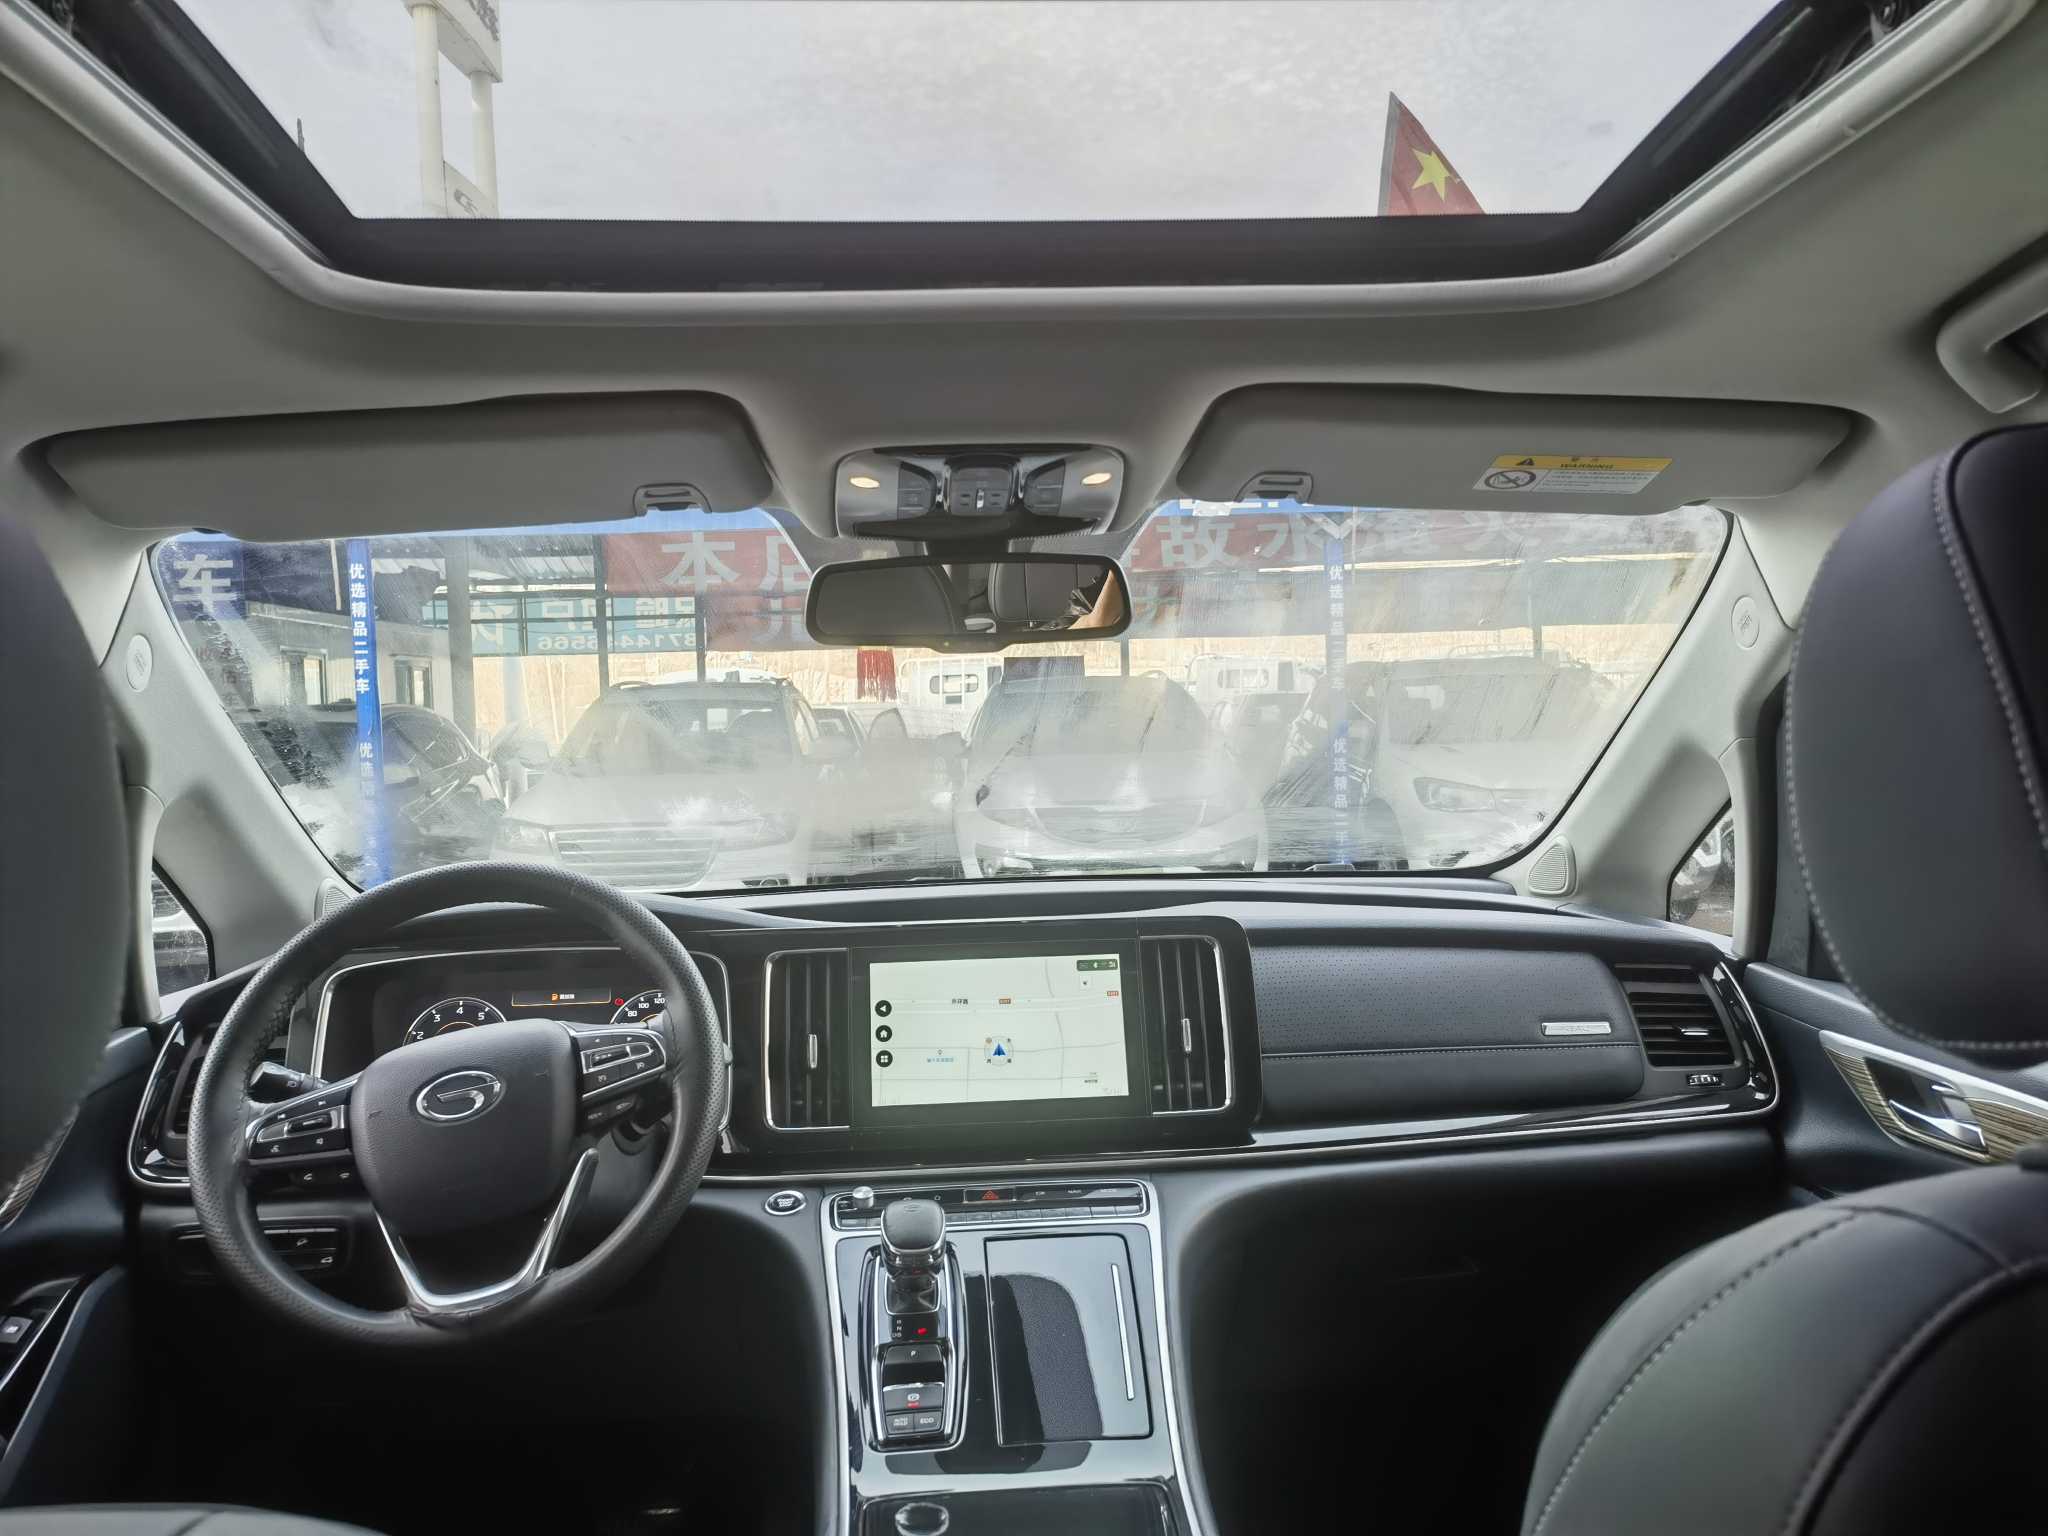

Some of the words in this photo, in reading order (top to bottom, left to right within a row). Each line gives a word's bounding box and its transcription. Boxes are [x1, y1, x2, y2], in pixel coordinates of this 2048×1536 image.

[173, 553, 238, 612] 车
[350, 563, 371, 694] 优选精品二手车
[433, 1014, 441, 1022] 3
[478, 1012, 485, 1020] 5
[416, 1031, 424, 1040] 2
